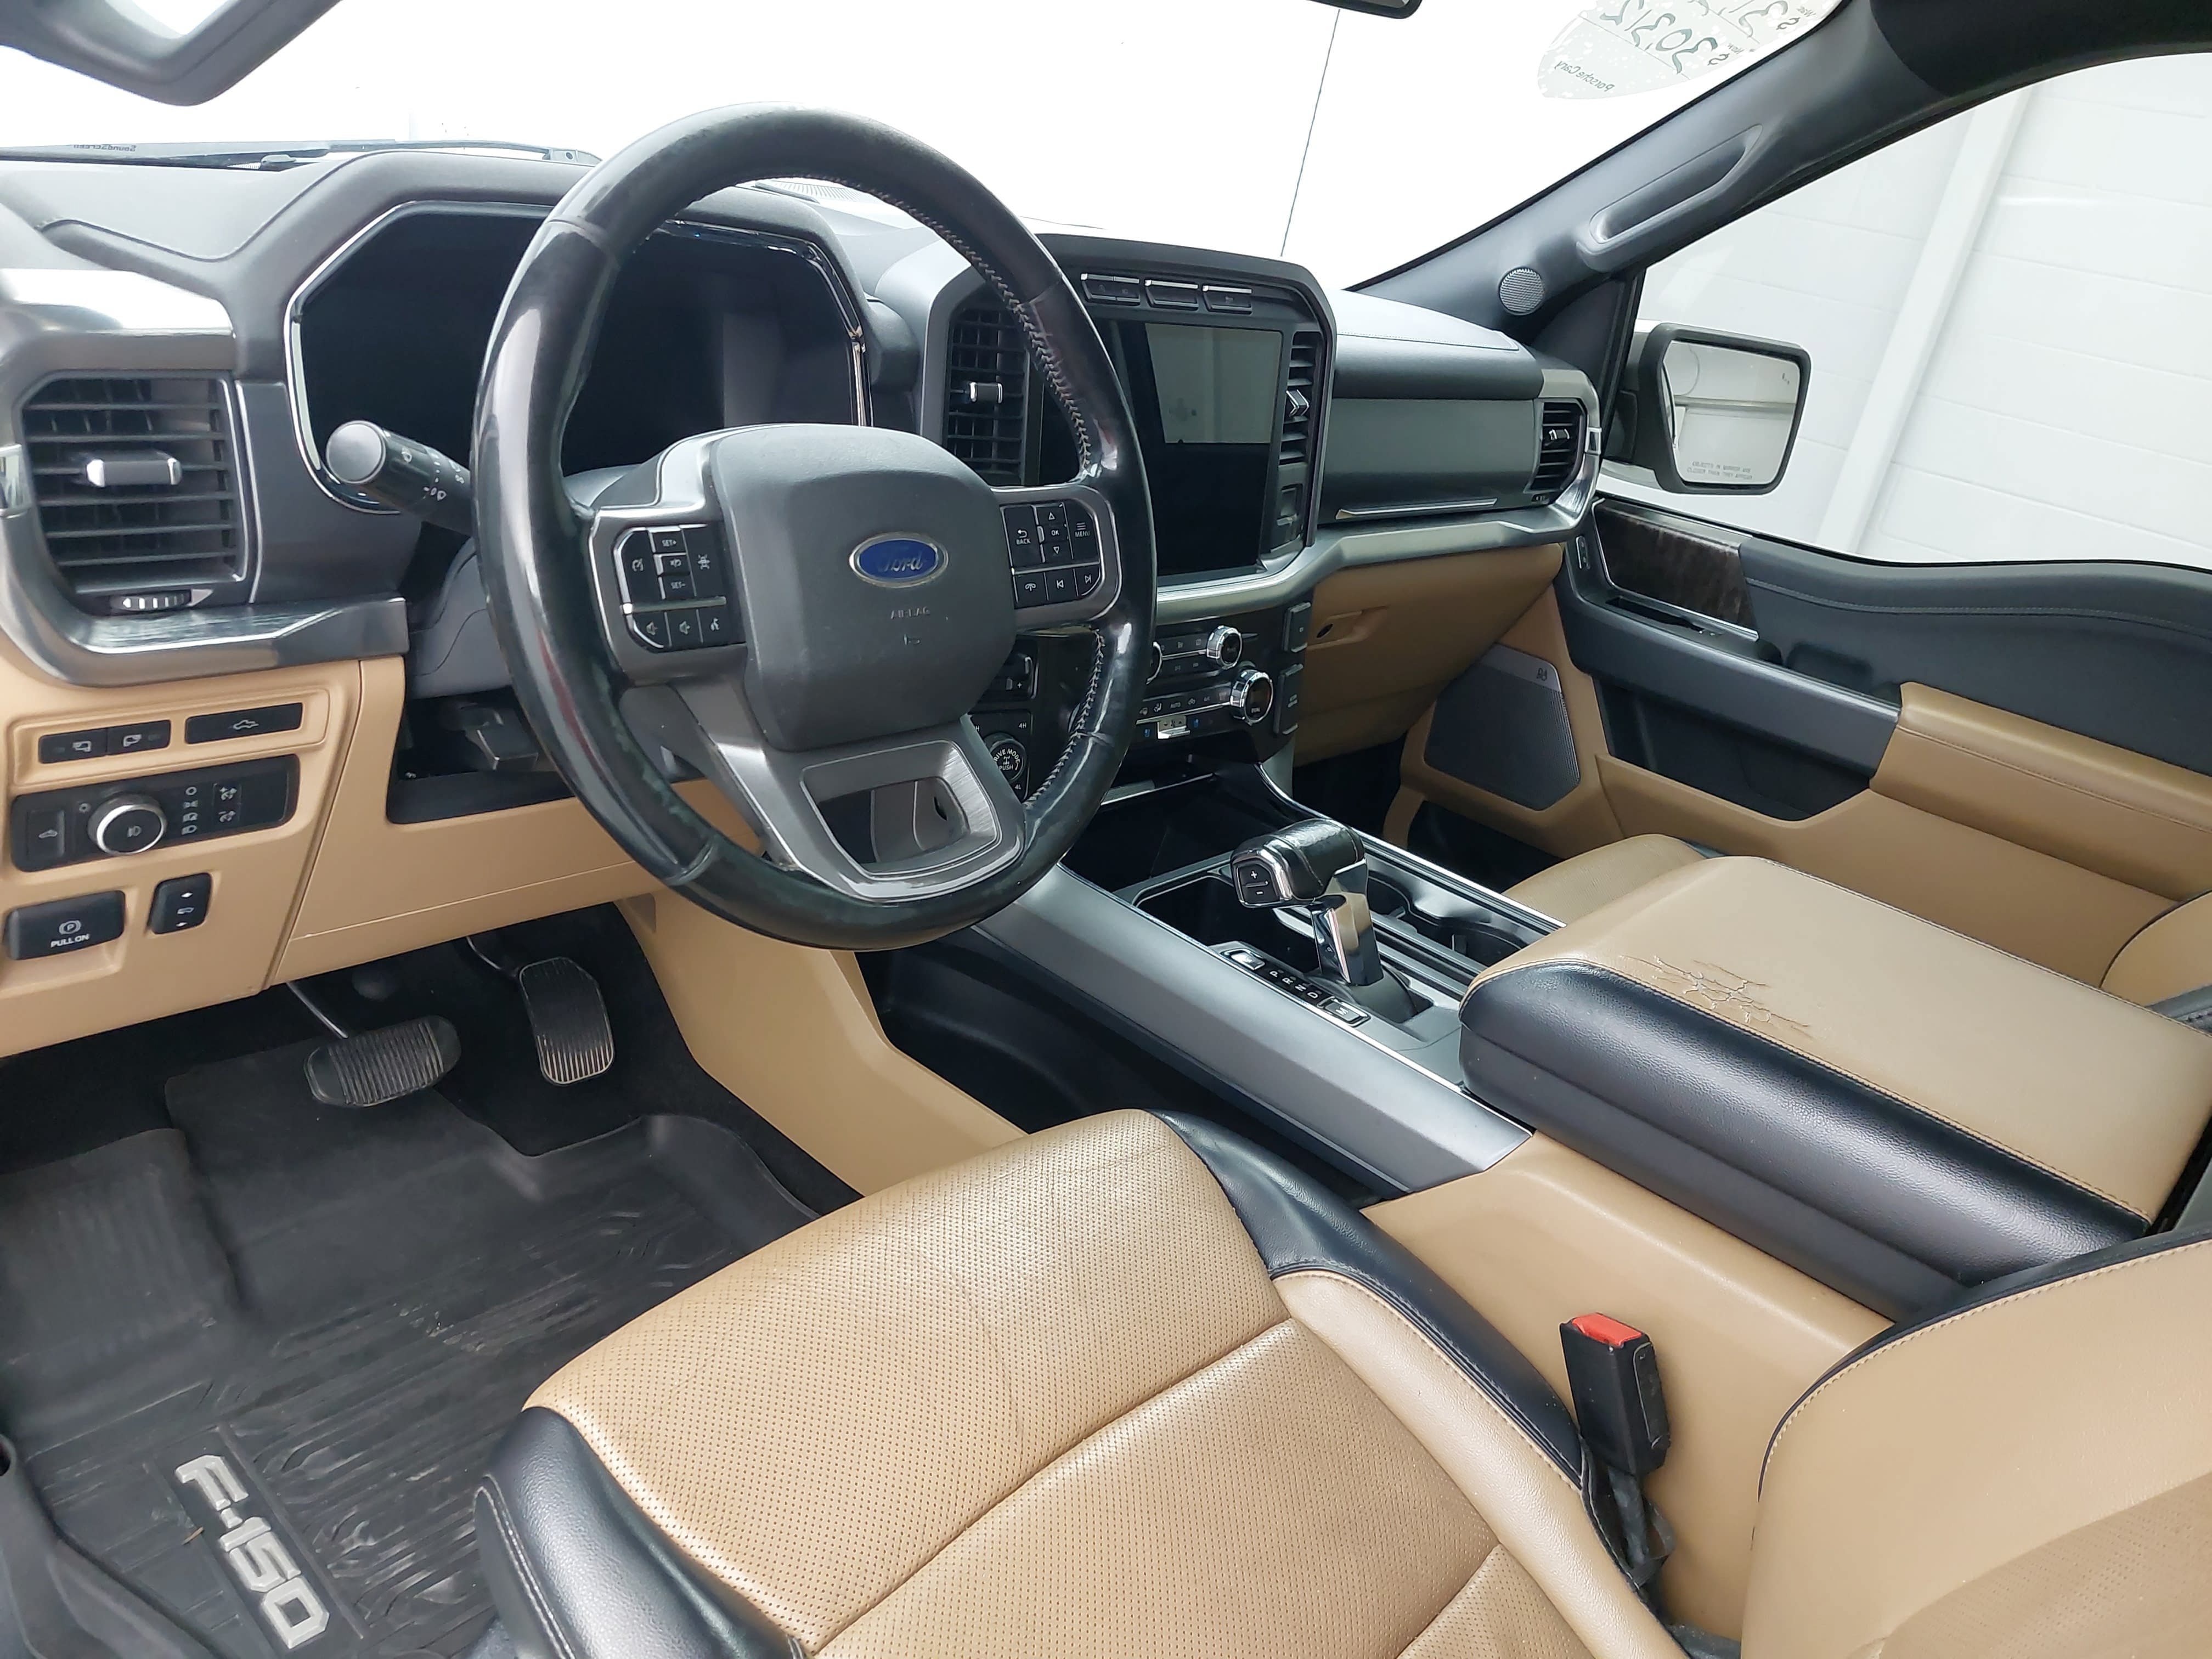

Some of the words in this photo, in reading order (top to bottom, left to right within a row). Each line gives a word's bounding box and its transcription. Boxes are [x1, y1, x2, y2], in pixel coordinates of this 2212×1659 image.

[993, 748, 1006, 762] RIVE
[1007, 748, 1020, 764] MODE
[50, 937, 75, 948] PULL
[74, 933, 89, 943] ON
[176, 1454, 330, 1649] F-150
